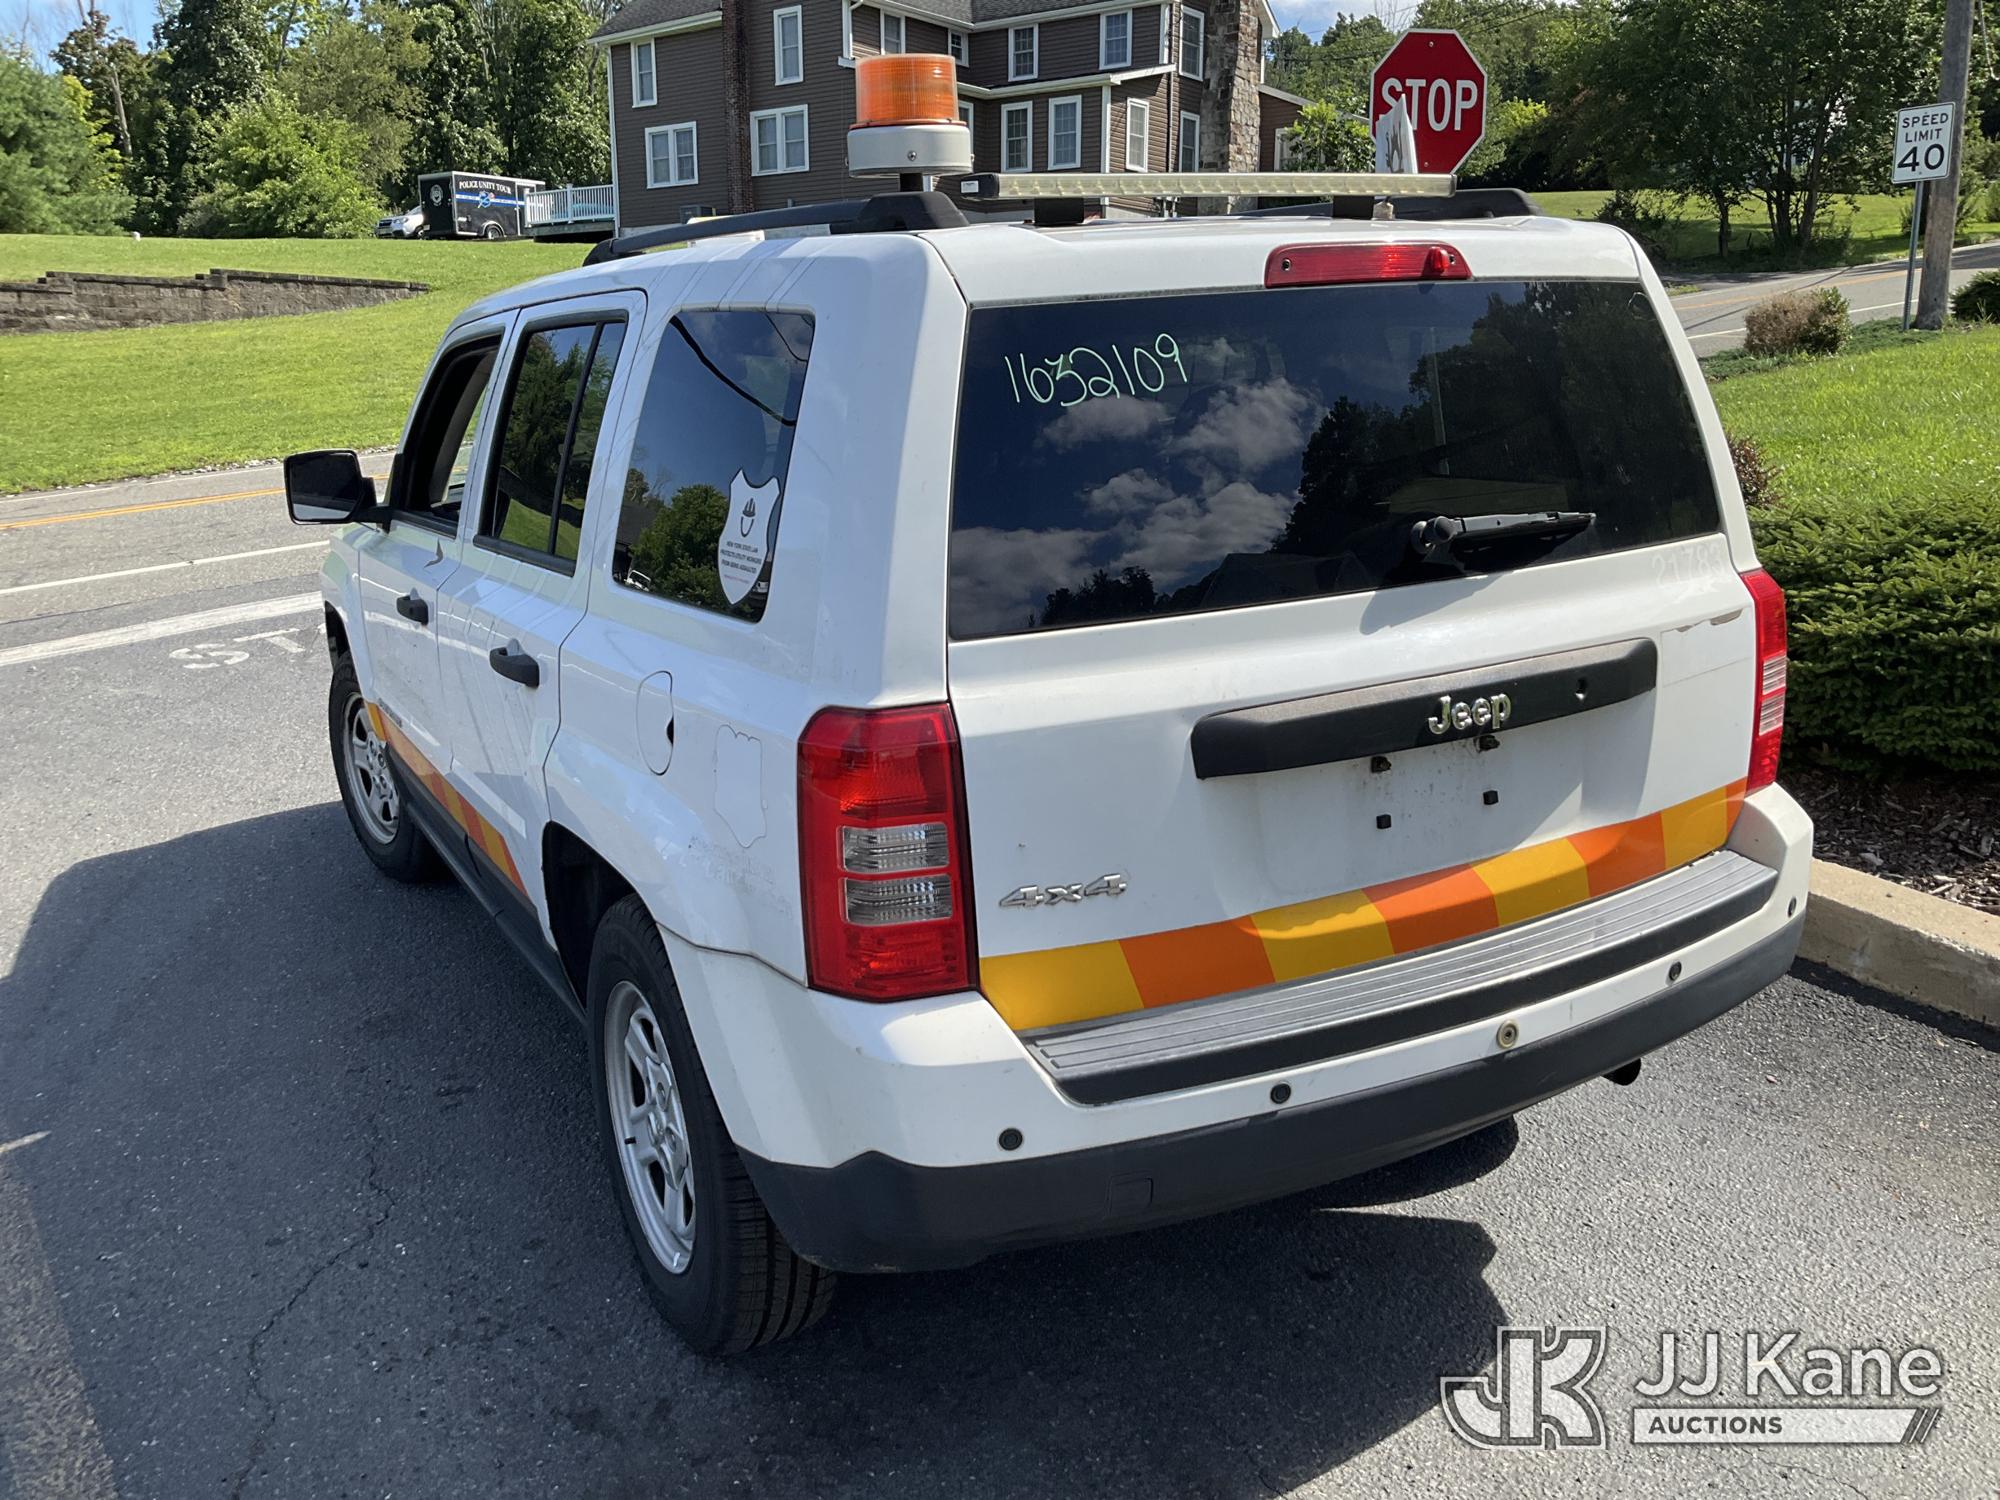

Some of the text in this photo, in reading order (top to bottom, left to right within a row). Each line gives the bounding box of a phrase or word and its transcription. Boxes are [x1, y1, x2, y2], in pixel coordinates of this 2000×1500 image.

[1380, 78, 1478, 131] STOP
[1902, 113, 1949, 128] SPEED
[1905, 128, 1942, 143] LIMIT
[1897, 143, 1945, 172] 40
[459, 181, 511, 194] POLICE UNITY TOUR
[1004, 333, 1187, 407] 1632109
[1428, 693, 1512, 735] Jeep
